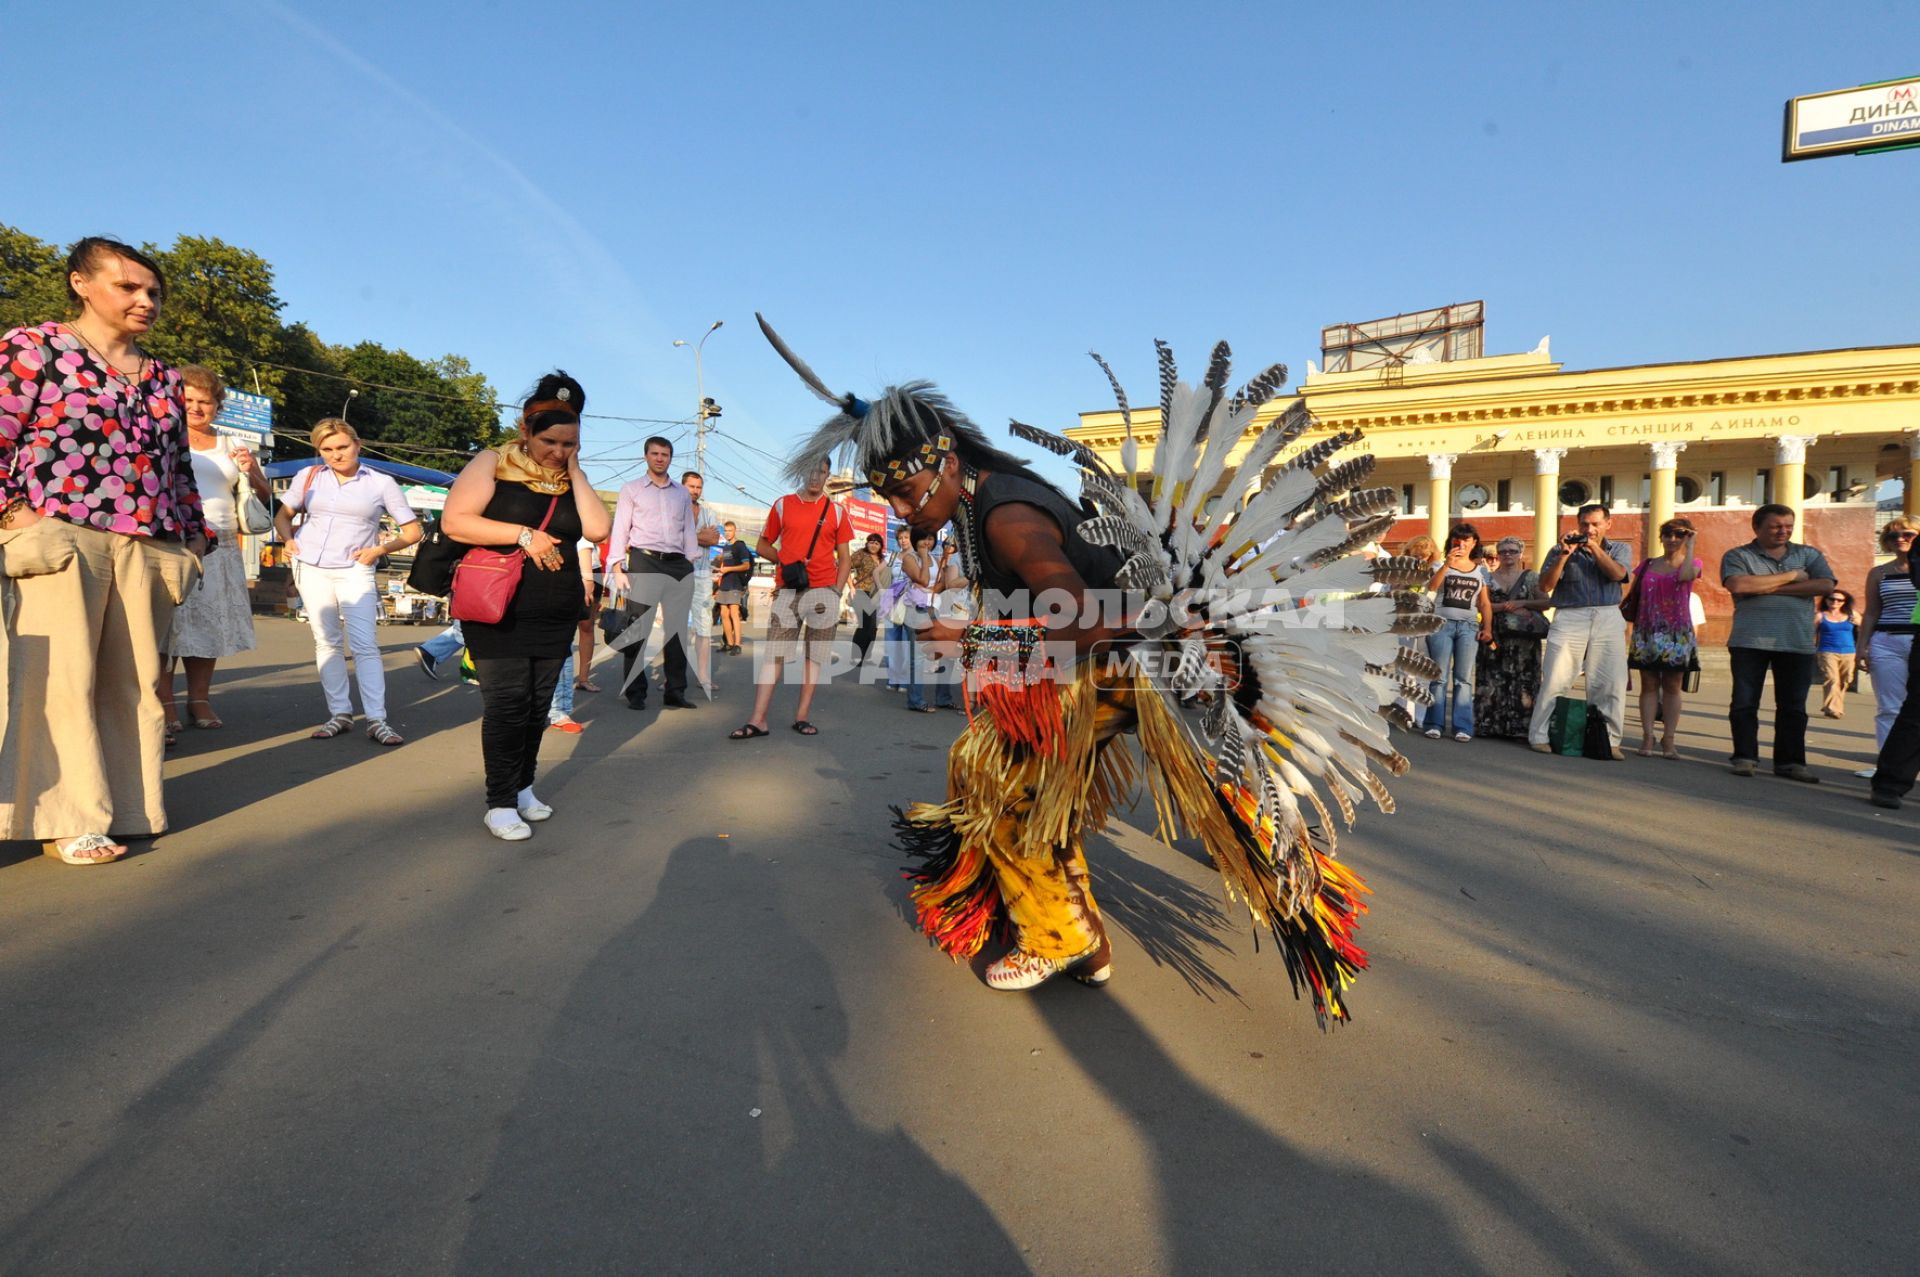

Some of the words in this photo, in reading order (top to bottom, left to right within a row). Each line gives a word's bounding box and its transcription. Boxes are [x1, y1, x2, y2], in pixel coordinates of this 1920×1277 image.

[1849, 100, 1918, 124] ДИНА
[1515, 428, 1585, 441] ЛЕНИНА
[1607, 422, 1694, 436] СТАНЦИЯ
[1710, 414, 1801, 430] ДИНАМО
[1445, 588, 1473, 601] MC
